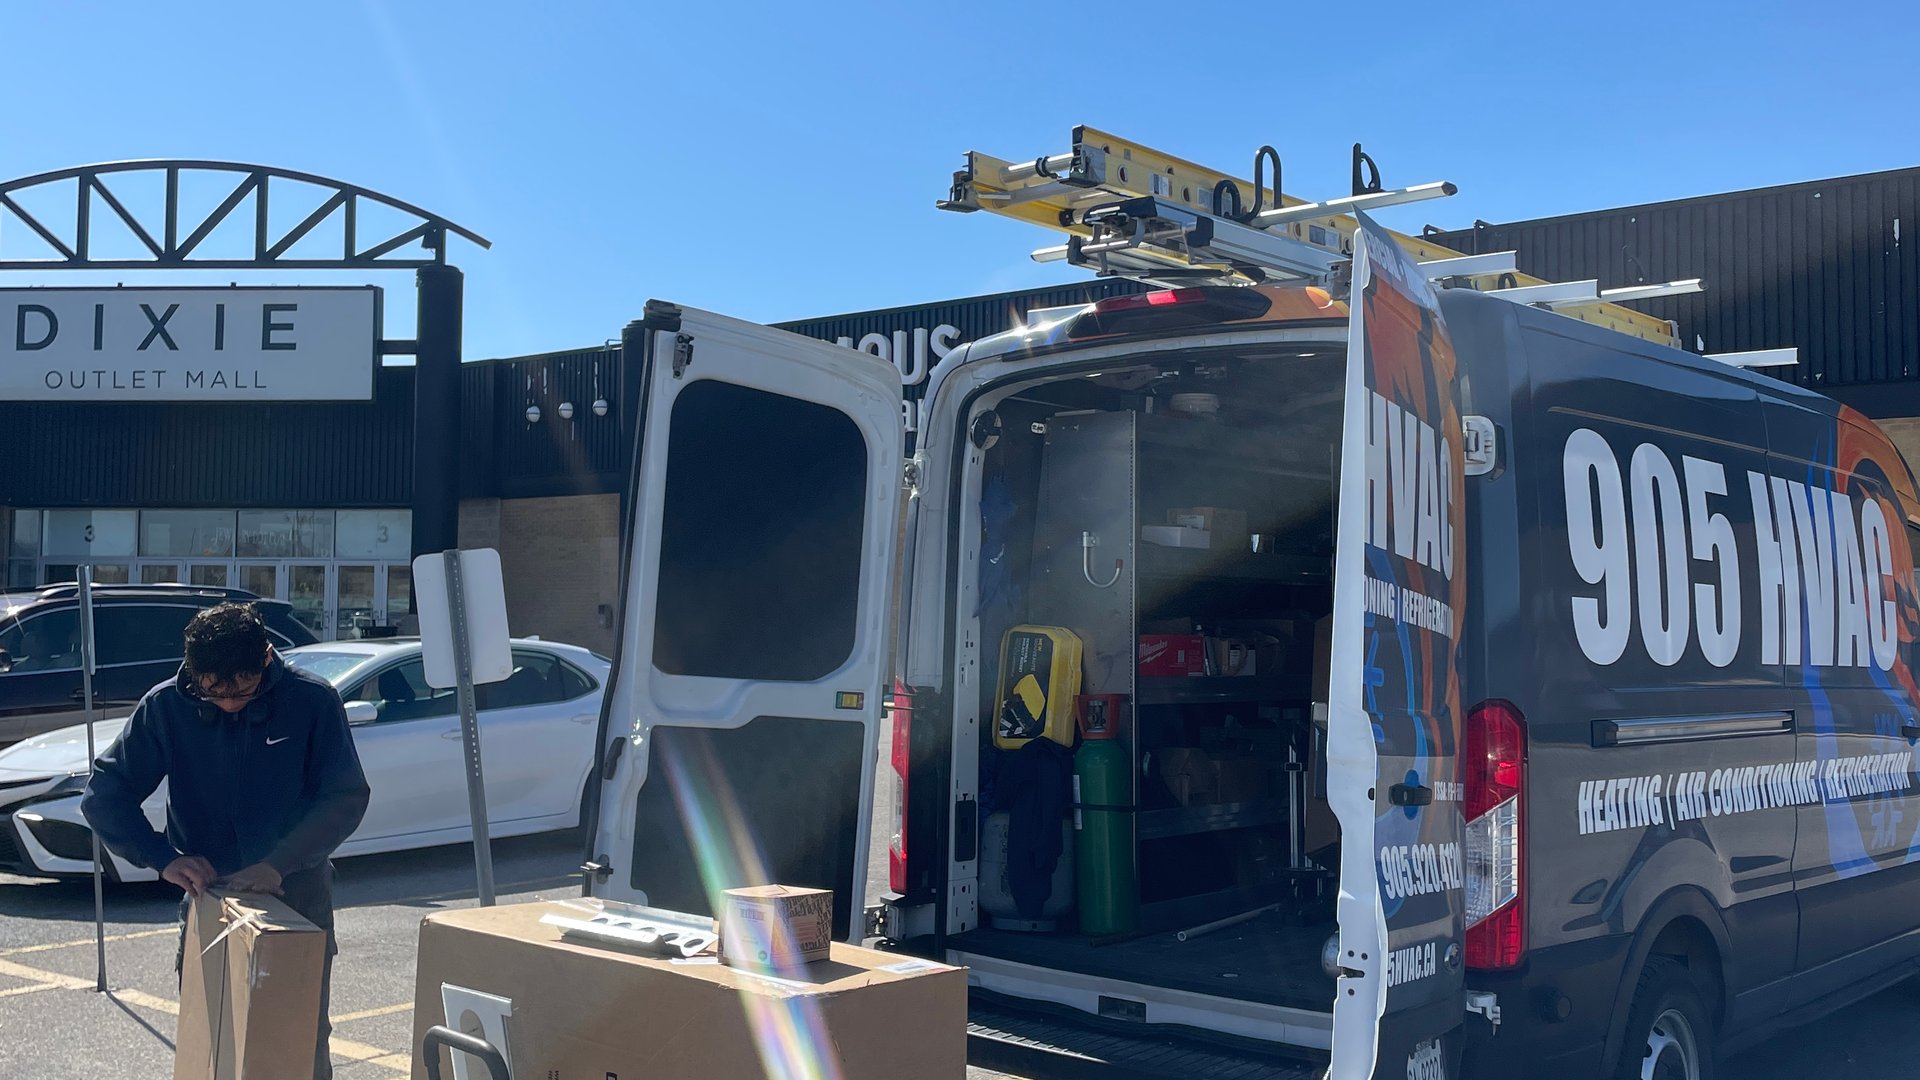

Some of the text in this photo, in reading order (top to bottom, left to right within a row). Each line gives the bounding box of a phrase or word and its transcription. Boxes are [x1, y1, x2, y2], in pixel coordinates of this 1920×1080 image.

[16, 303, 298, 352] DIXIE
[45, 369, 268, 390] OUTLET MALL
[1364, 386, 1454, 581] HVAC
[84, 524, 96, 543] 3
[377, 525, 389, 543] 3
[1562, 428, 1898, 672] 905 HVAC
[1579, 774, 1664, 835] HEATING
[1675, 771, 1707, 821] AIR
[1709, 759, 1819, 817] CONDITIONING
[1827, 751, 1912, 800] REFRIGERATION
